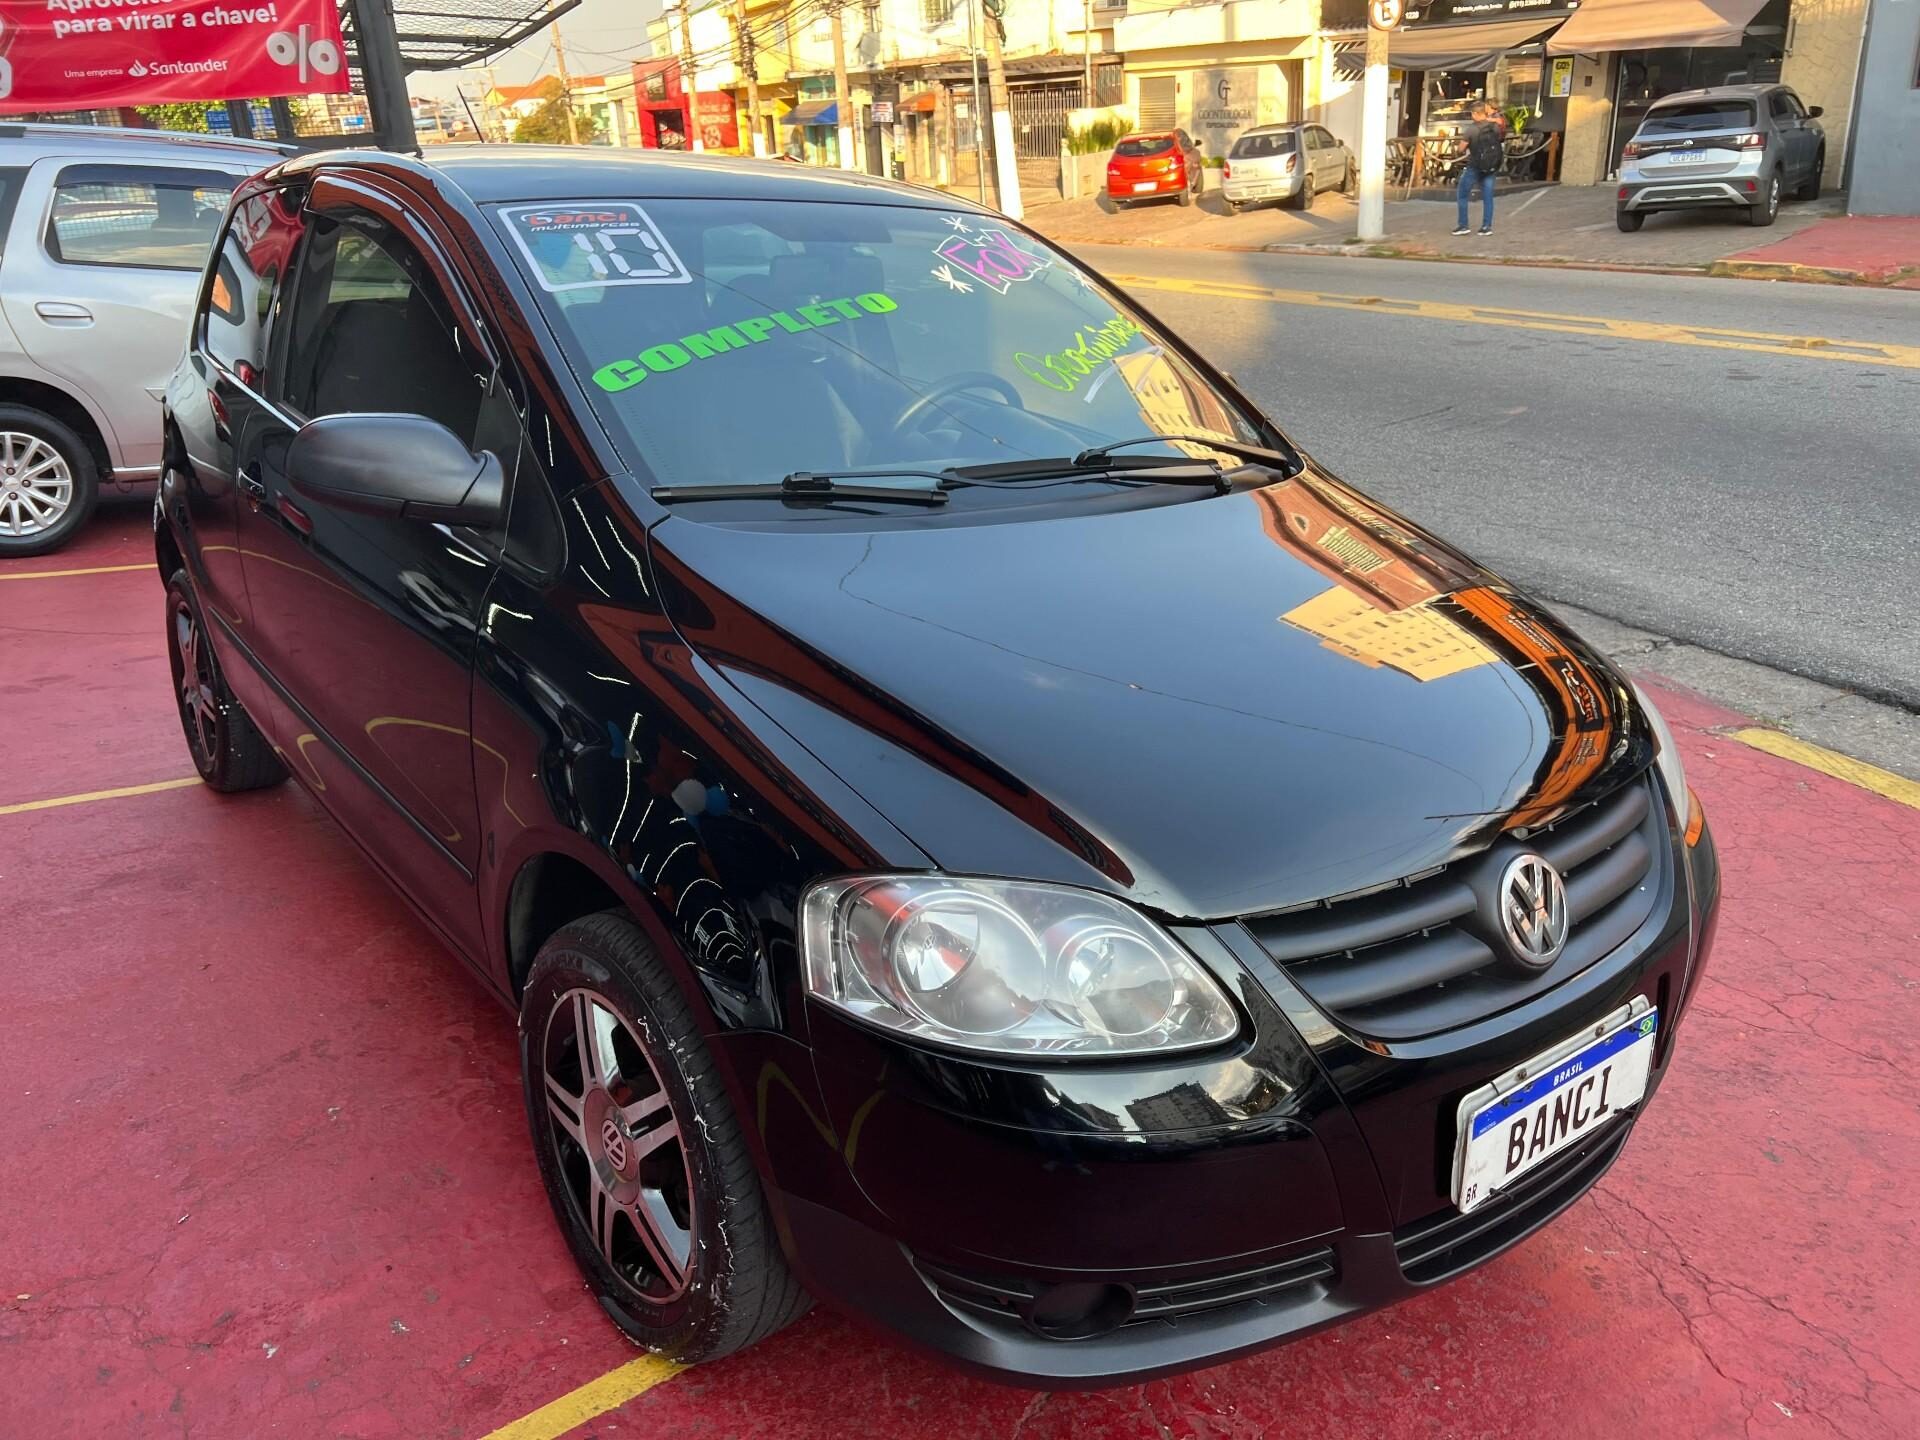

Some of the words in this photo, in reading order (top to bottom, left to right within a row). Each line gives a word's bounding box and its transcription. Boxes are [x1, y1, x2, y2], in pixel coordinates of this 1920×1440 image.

[53, 17, 112, 38] para
[117, 11, 176, 31] virar
[182, 12, 197, 28] a
[201, 2, 278, 26] chave!
[64, 69, 85, 78] Uma
[86, 68, 124, 78] empresa
[149, 59, 228, 76] Santander
[529, 211, 628, 226] banci
[530, 222, 641, 233] multimarcas
[573, 228, 675, 277] 10
[591, 292, 899, 392] COMPLETO
[1553, 1061, 1583, 1087] BRASIL
[1505, 1066, 1612, 1175] BANCI
[1465, 1183, 1478, 1204] BR
